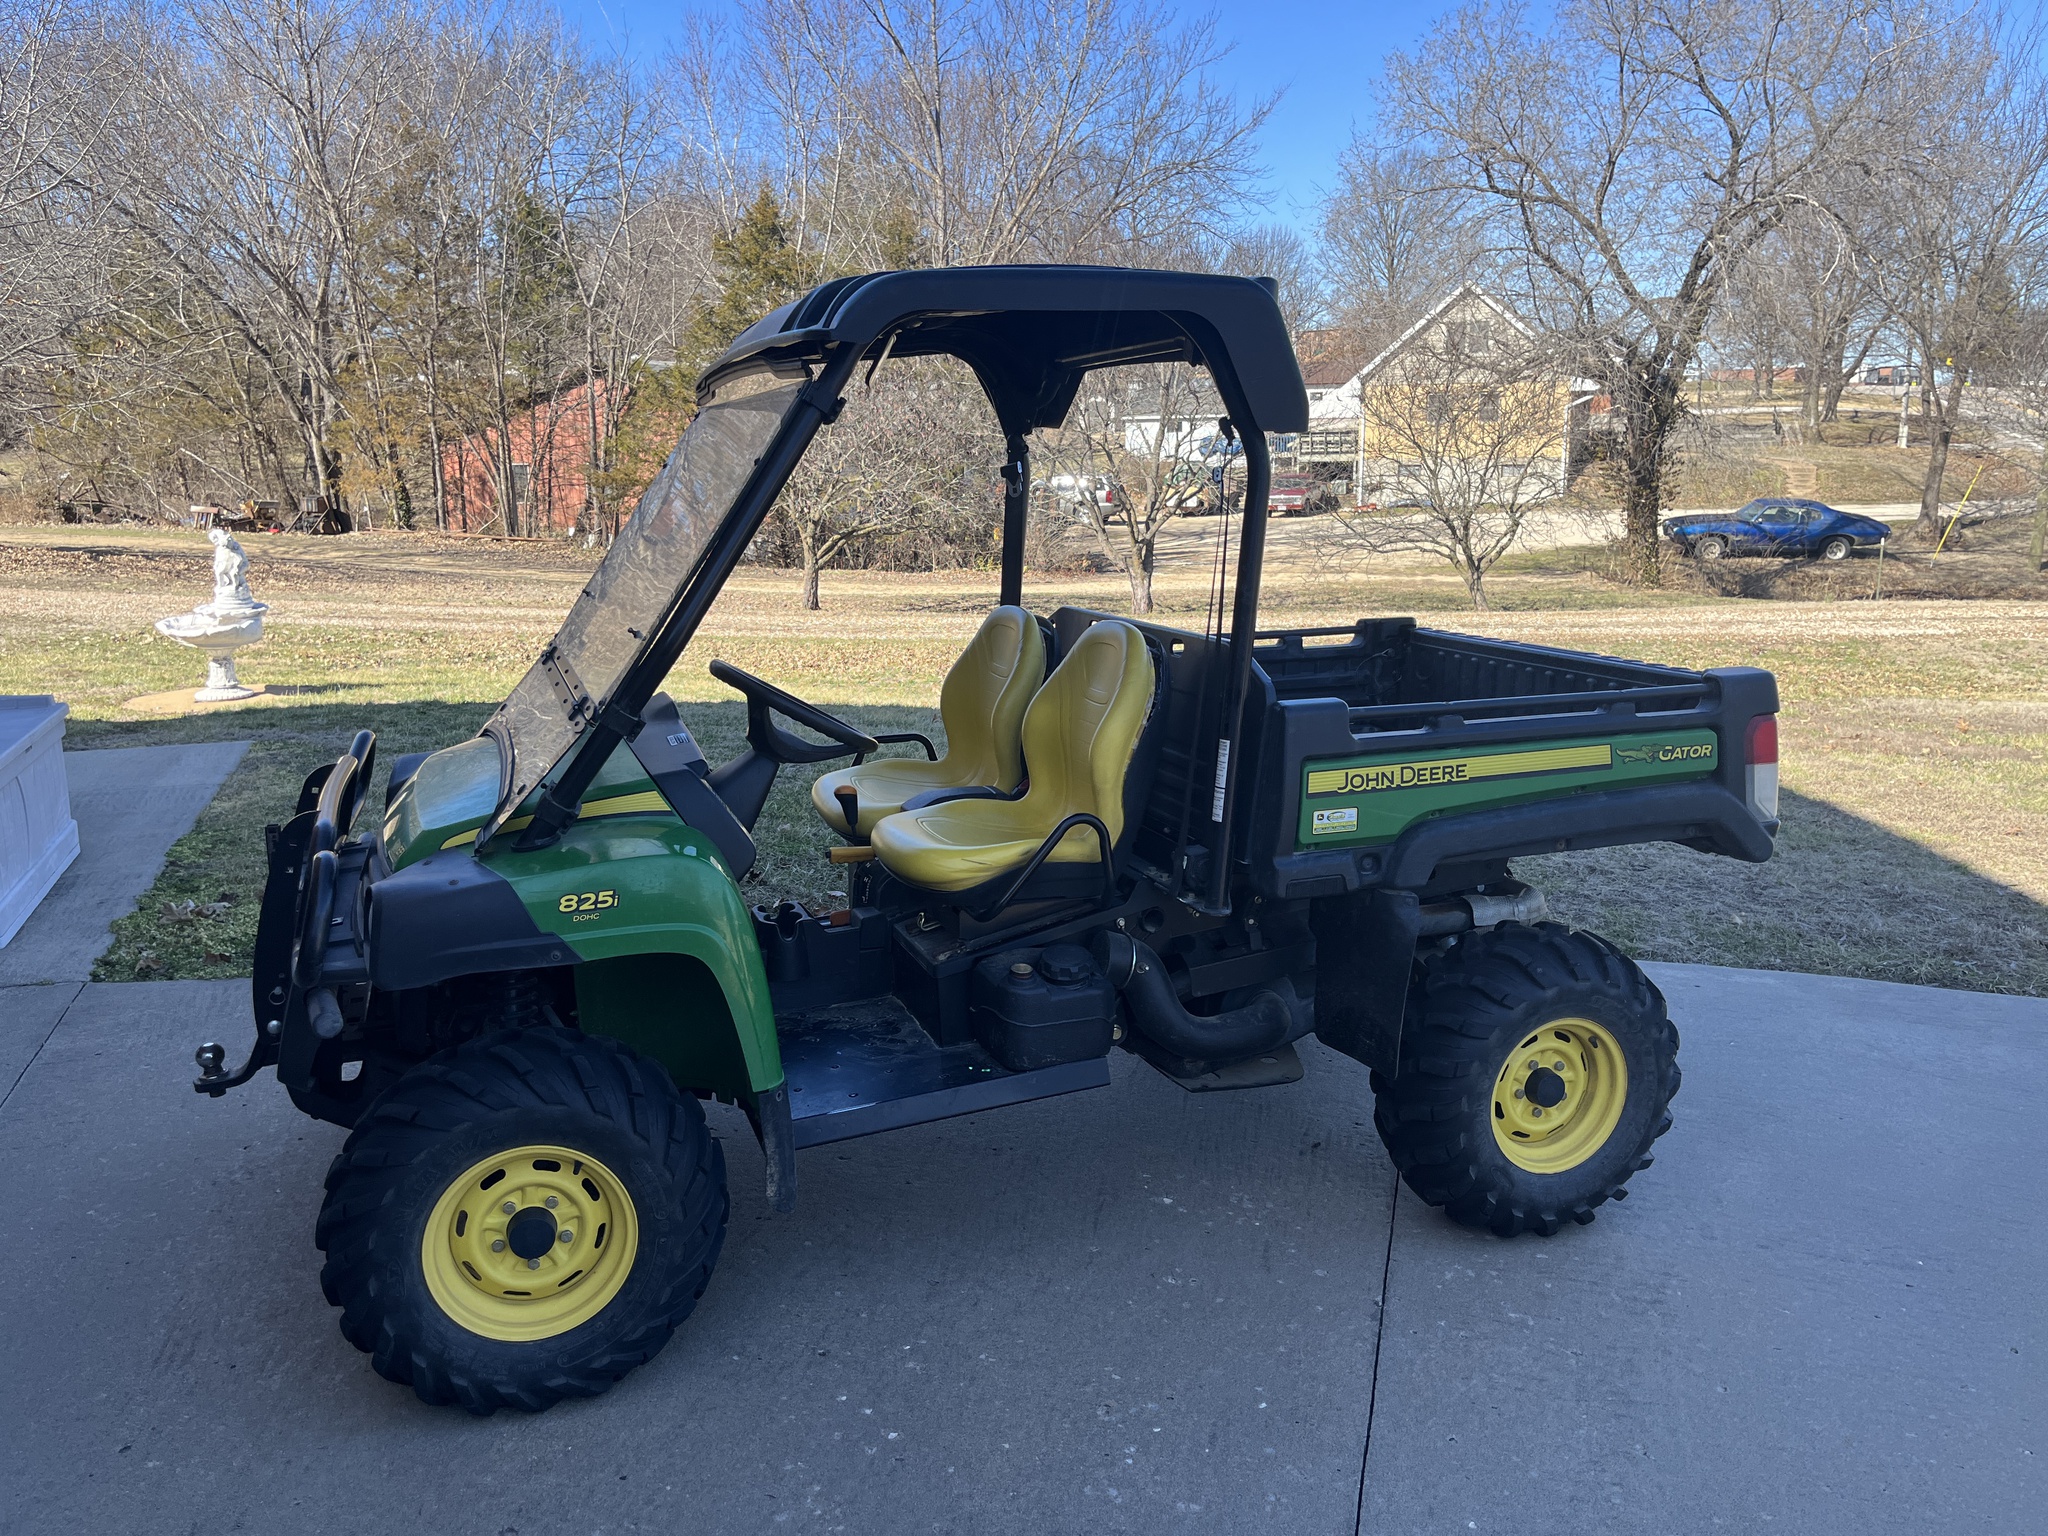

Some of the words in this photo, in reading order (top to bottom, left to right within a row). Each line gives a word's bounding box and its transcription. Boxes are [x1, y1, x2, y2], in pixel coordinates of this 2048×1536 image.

[1659, 744, 1713, 761] GATOR
[1336, 770, 1395, 792] JOHN
[1400, 763, 1468, 785] DEERE
[558, 890, 619, 912] 825i
[572, 912, 600, 922] DOHC
